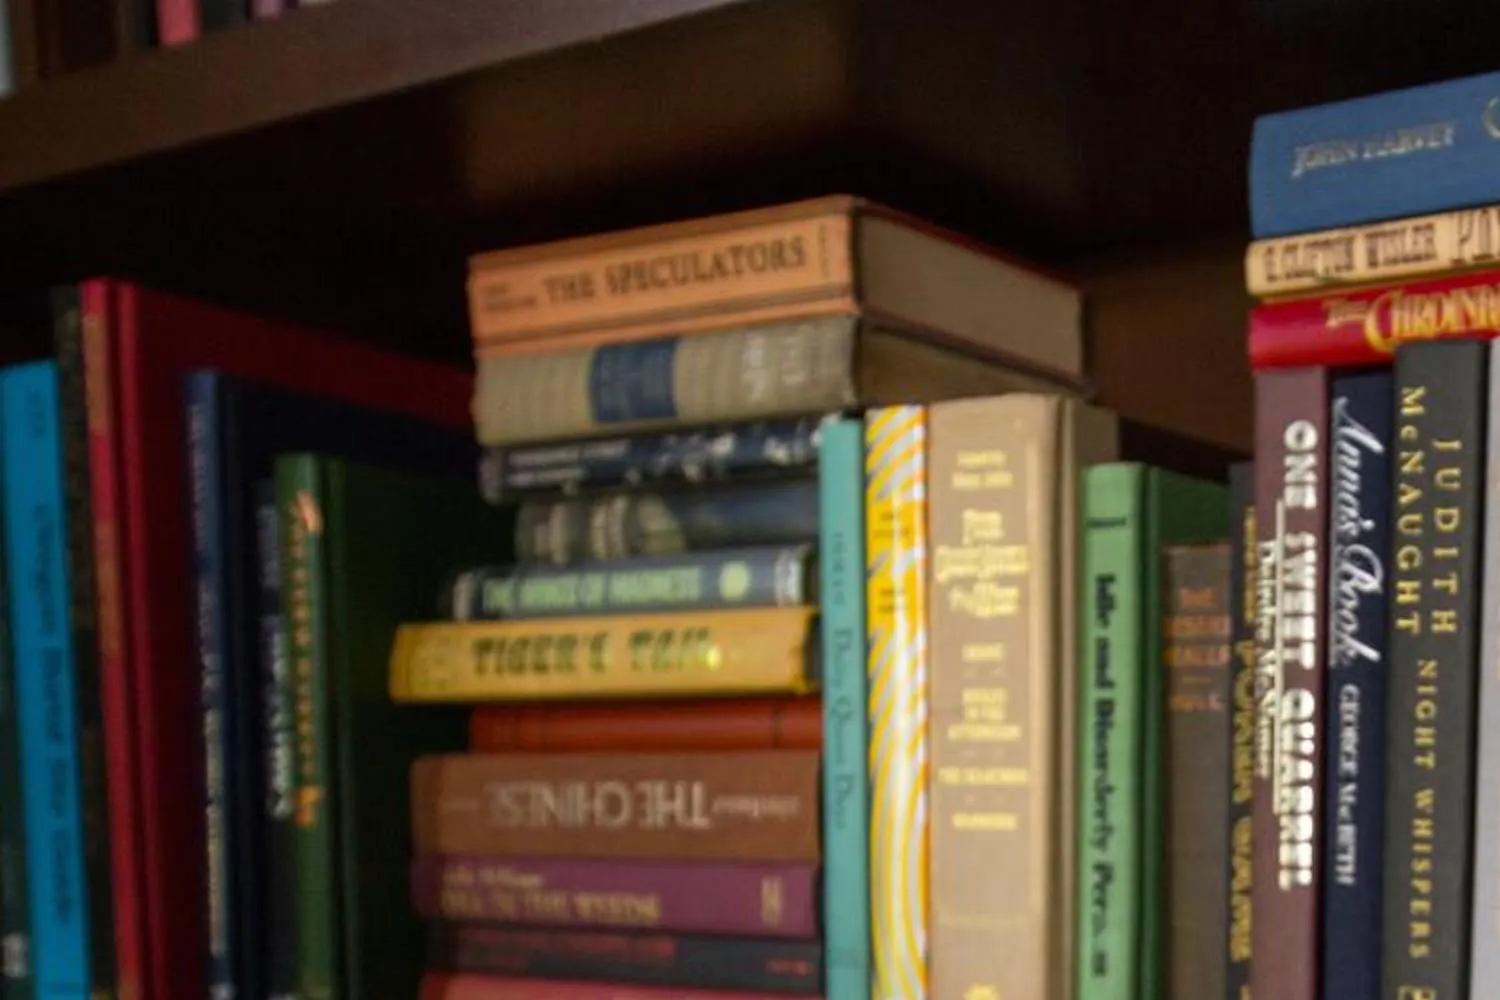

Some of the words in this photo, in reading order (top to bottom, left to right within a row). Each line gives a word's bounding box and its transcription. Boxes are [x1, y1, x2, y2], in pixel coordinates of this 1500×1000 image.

[543, 271, 597, 305] THE
[605, 236, 807, 294] SPECULATORS
[1283, 419, 1318, 510] ONE
[1329, 396, 1386, 542] Anna's
[1394, 386, 1427, 637] McNAUGHT
[1281, 531, 1318, 670] SWEET
[1330, 544, 1383, 669] Book
[1430, 439, 1463, 636] JUDITH
[1338, 683, 1361, 776] GEORGE
[1412, 659, 1438, 770] NIGHT
[1278, 689, 1318, 892] QUARREL
[1408, 788, 1436, 960] WHISPERS
